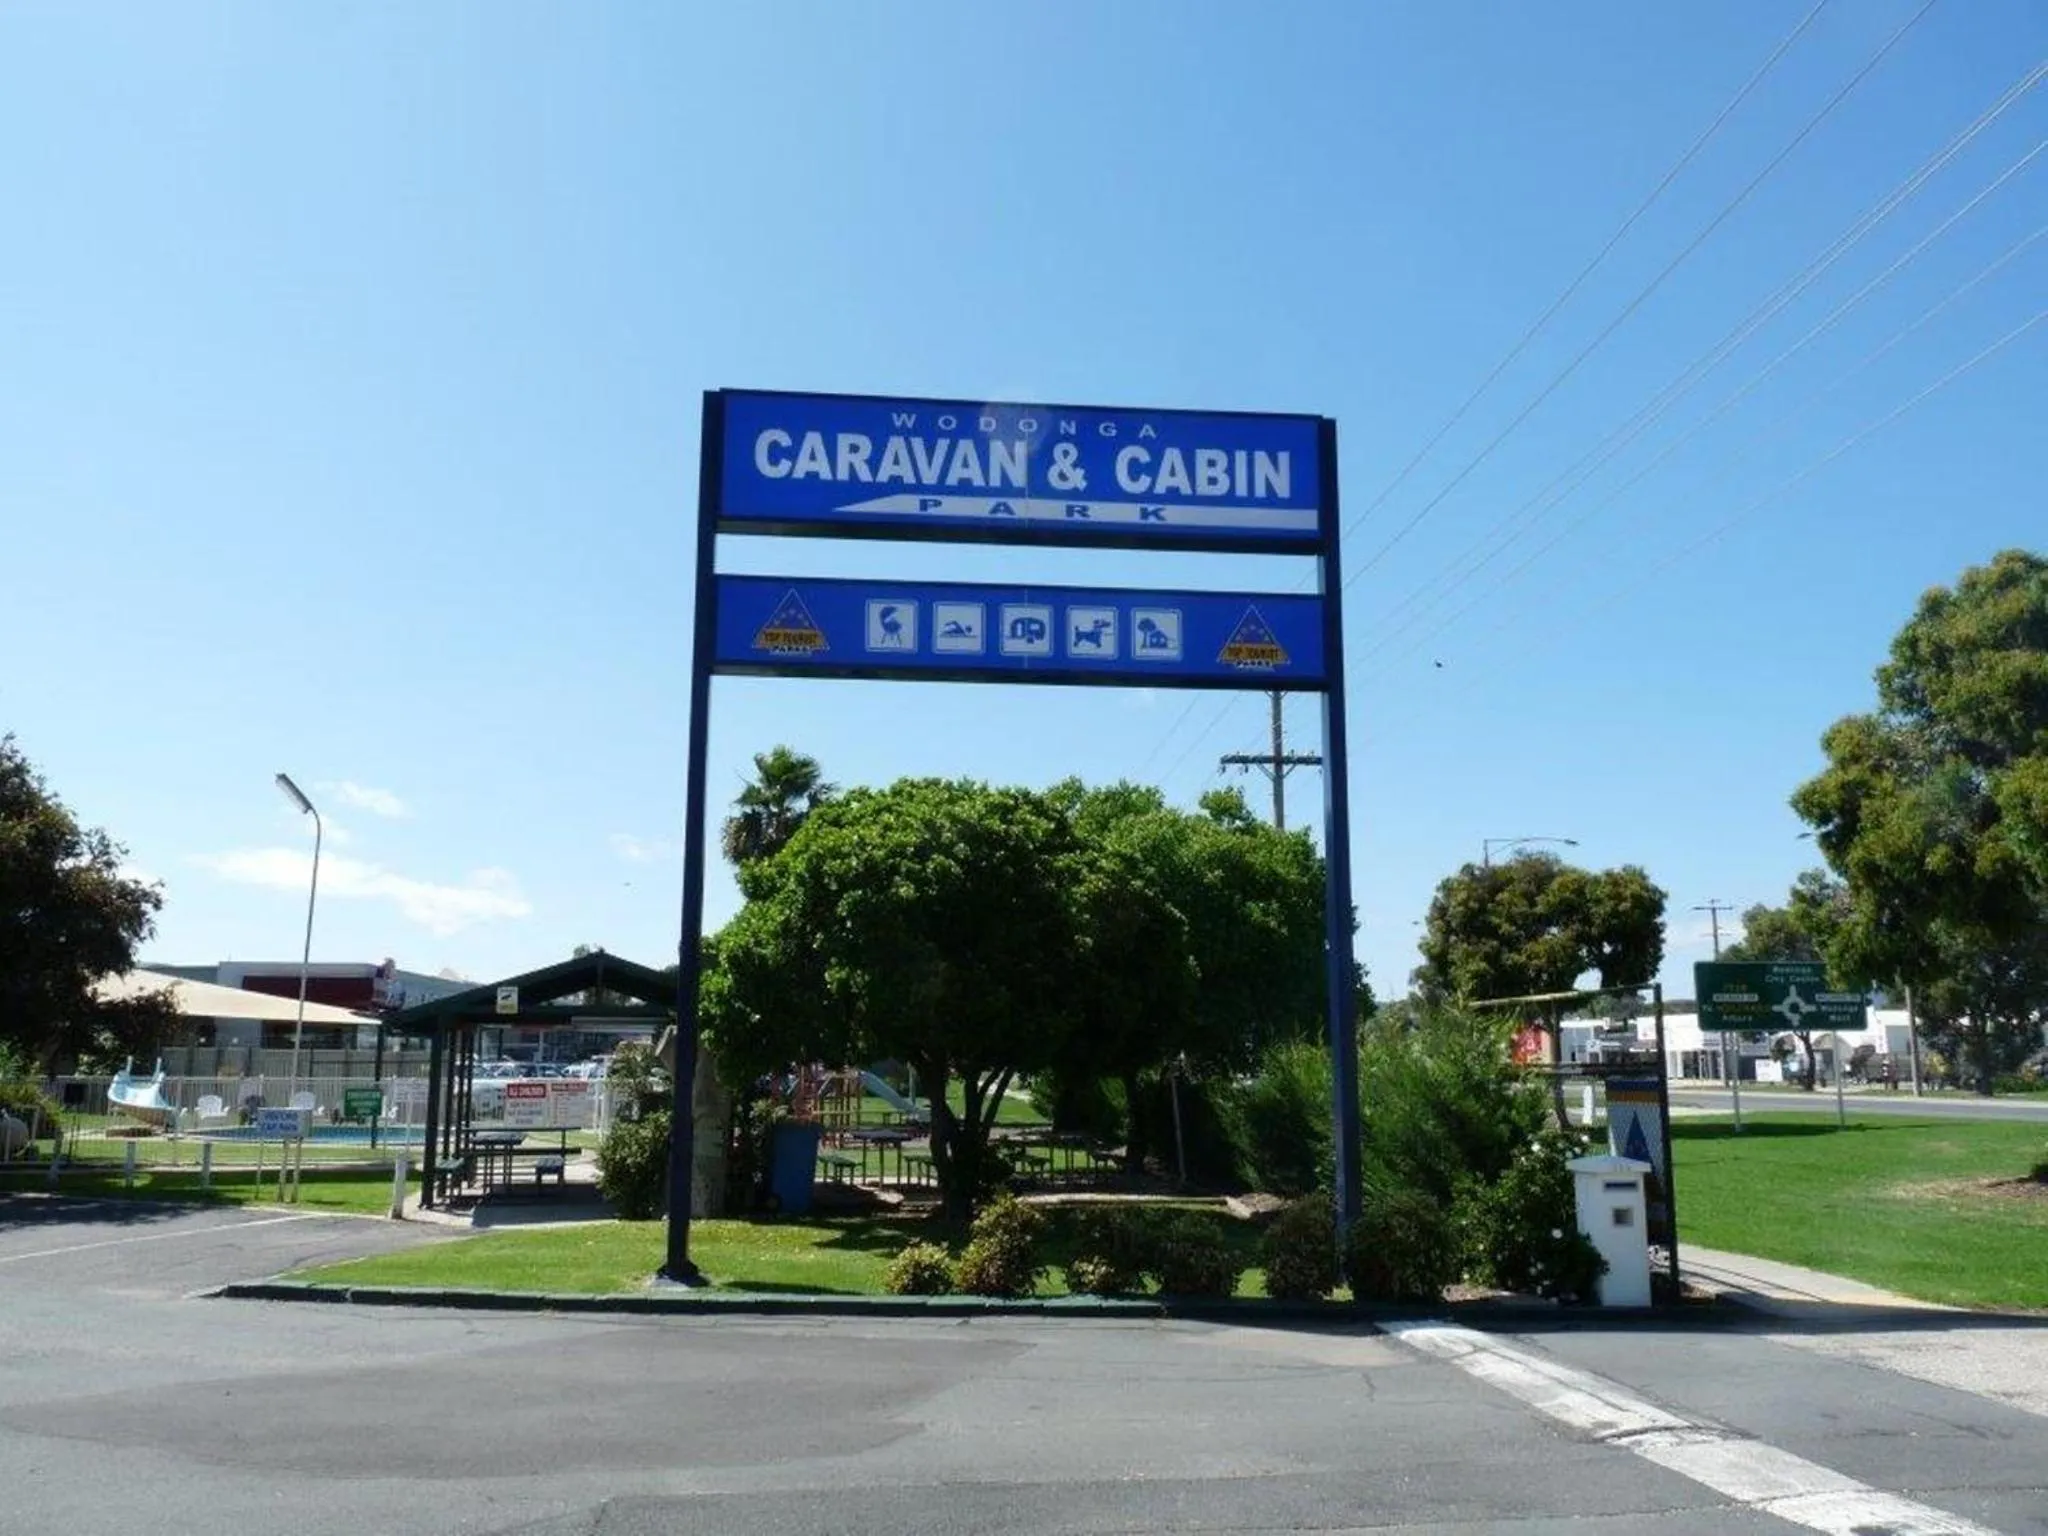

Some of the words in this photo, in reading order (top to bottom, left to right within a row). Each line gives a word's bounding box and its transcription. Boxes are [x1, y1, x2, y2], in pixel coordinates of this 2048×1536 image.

[891, 411, 1157, 439] WODONGA
[754, 428, 1028, 488] CARAVAN
[1047, 442, 1087, 491] &
[1115, 445, 1291, 498] CABIN
[918, 498, 1167, 522] PARK
